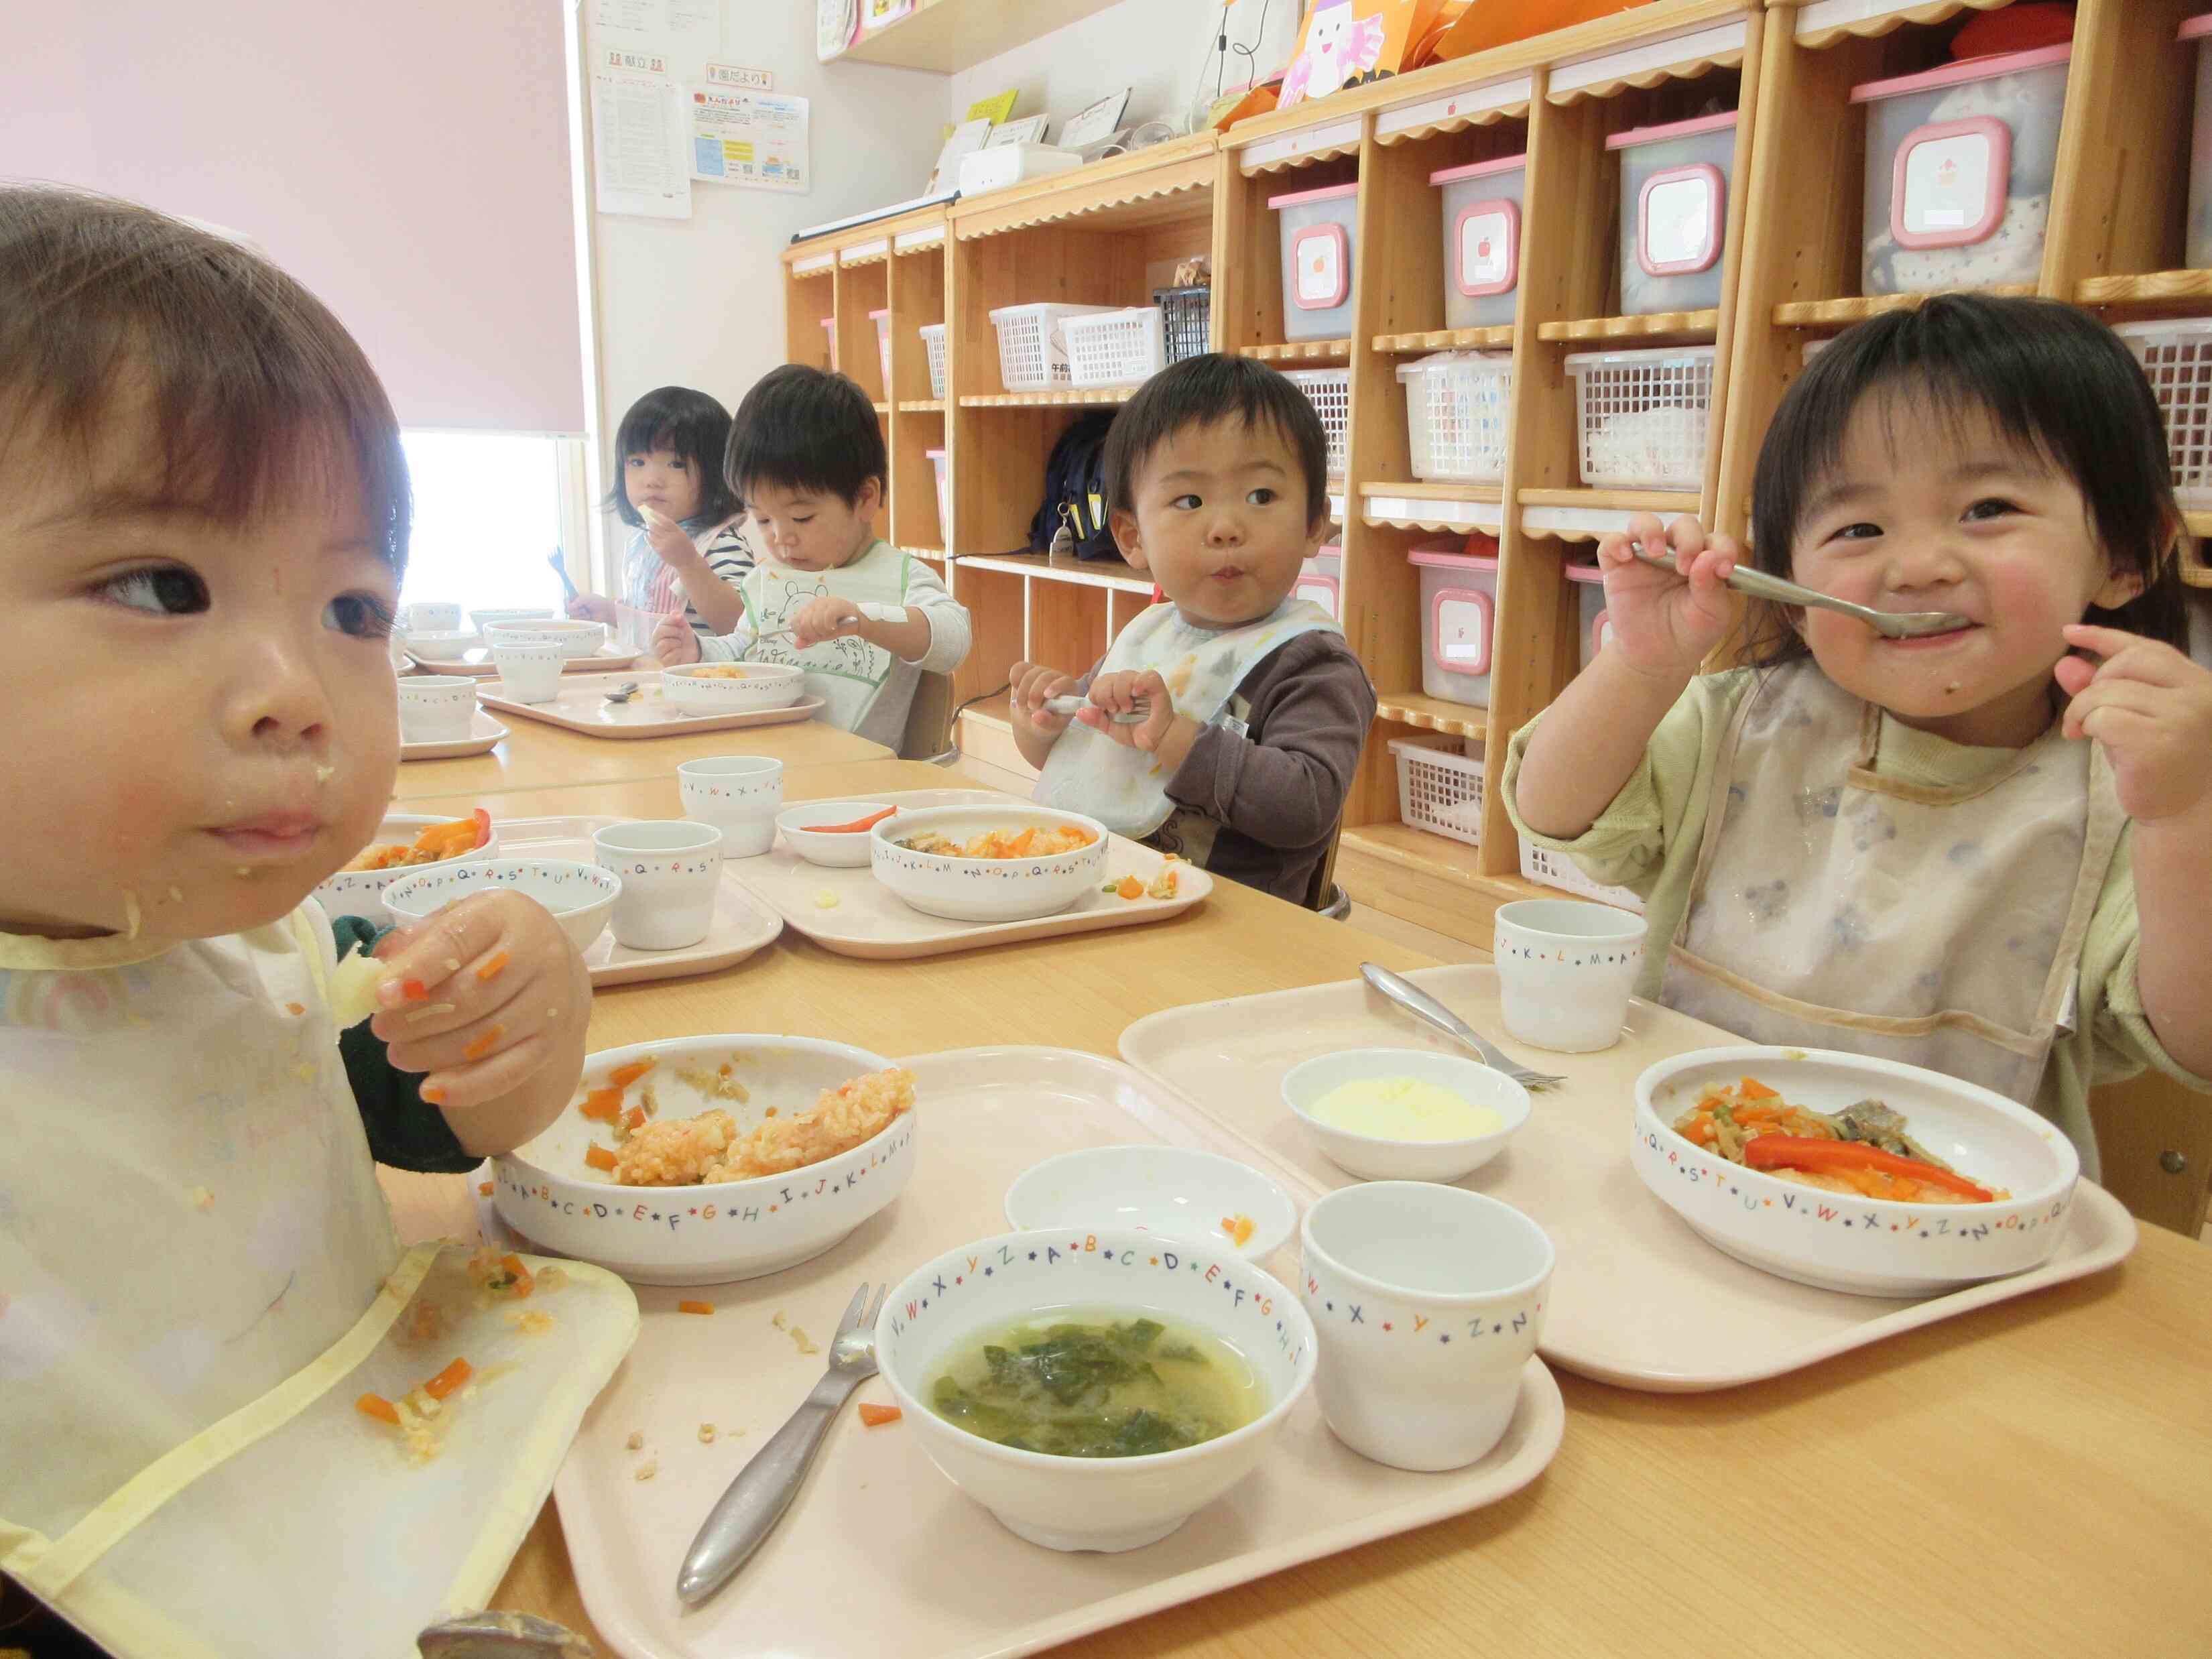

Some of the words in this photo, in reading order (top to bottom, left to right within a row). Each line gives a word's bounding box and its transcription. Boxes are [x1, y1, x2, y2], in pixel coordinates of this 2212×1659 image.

[718, 69, 760, 85] 園だより
[457, 869, 470, 879] Q
[509, 871, 517, 881] S
[635, 864, 648, 874] Q
[1032, 866, 1042, 876] Q
[1523, 948, 1532, 959] K
[1589, 953, 1601, 965] M
[1649, 1133, 1658, 1150] Q
[1689, 1168, 1699, 1182] S
[1715, 1174, 1725, 1187] T
[1744, 1195, 1758, 1210] U
[1783, 1193, 1795, 1209] V
[1817, 1204, 1839, 1221] W
[1863, 1213, 1880, 1229] X
[1937, 1219, 1951, 1234] Z
[2005, 1215, 2019, 1229] O
[564, 1202, 574, 1215] C
[593, 1203, 607, 1217] D
[633, 1205, 648, 1221] E
[669, 1214, 680, 1230] F
[702, 1205, 718, 1220] G
[742, 1207, 759, 1222] H
[780, 1187, 794, 1204] I
[815, 1179, 826, 1194] J
[846, 1172, 857, 1188] K
[906, 1299, 918, 1320] W
[932, 1274, 946, 1297] X
[967, 1255, 978, 1274] Y
[997, 1245, 1015, 1265] Z
[1048, 1246, 1061, 1265] A
[1085, 1234, 1097, 1252] B
[1121, 1251, 1135, 1266] C
[1164, 1252, 1179, 1269] D
[1205, 1264, 1221, 1283] E
[1234, 1289, 1245, 1307] F
[1261, 1298, 1272, 1316] G
[1348, 1304, 1364, 1325] X
[1414, 1313, 1429, 1331] Y
[1468, 1318, 1484, 1337] Z
